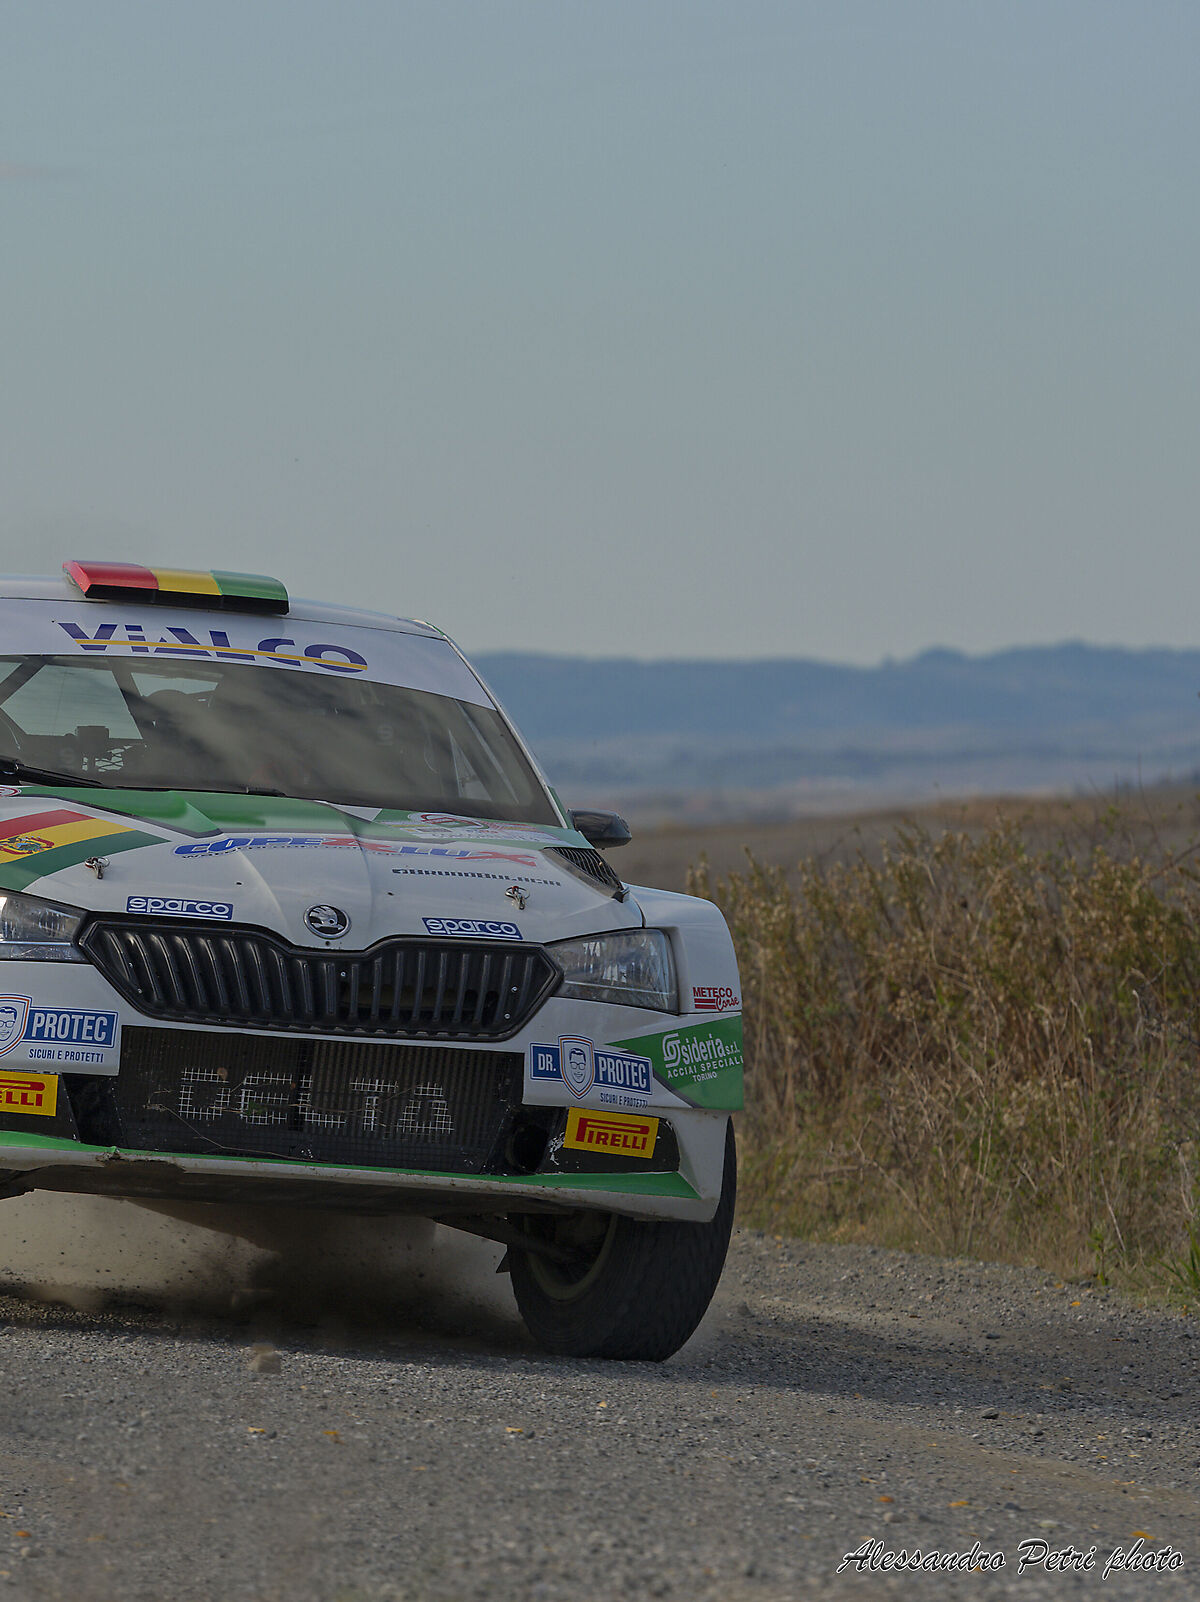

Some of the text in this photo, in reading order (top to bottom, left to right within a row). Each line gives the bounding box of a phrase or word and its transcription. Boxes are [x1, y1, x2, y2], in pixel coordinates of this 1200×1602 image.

[129, 897, 230, 915] sparco
[426, 919, 517, 935] sparco
[692, 986, 733, 998] METECO
[715, 995, 740, 1011] Corse
[31, 1011, 108, 1042] PROTEC
[28, 1048, 104, 1064] SICURI E PROTETTI
[681, 1033, 726, 1065] sideria
[538, 1053, 648, 1089] DR. PROTEC
[667, 1055, 744, 1079] ACCIAI SPECIALI
[692, 1071, 718, 1083] TORINO
[179, 1066, 455, 1135] DELTA
[600, 1092, 618, 1105] SICURI
[618, 1095, 623, 1105] E
[575, 1117, 650, 1150] PIRELLI
